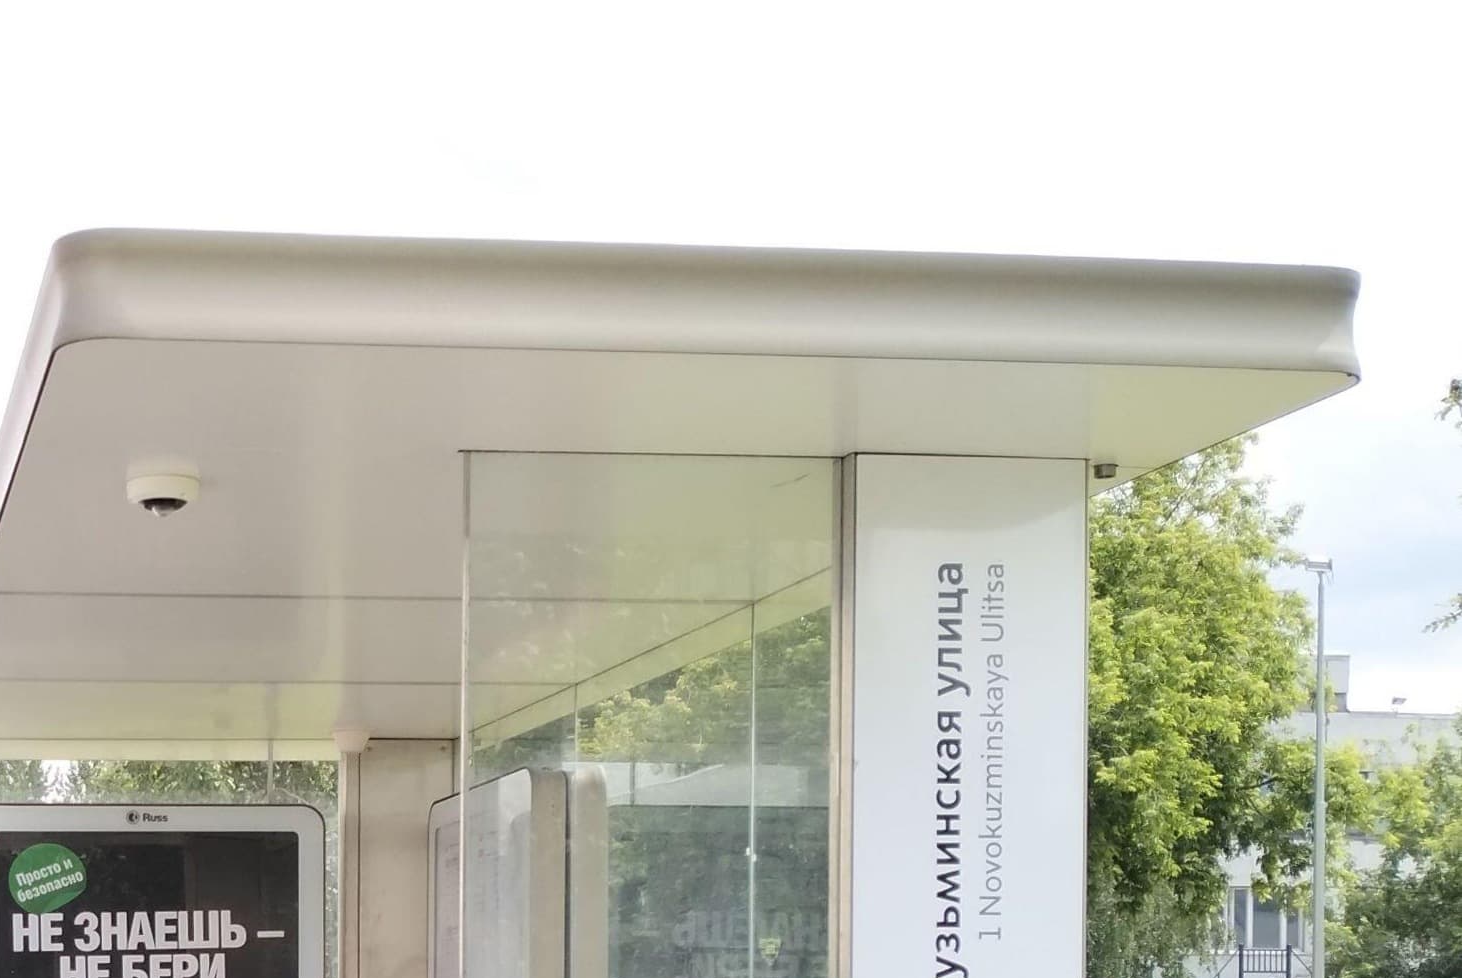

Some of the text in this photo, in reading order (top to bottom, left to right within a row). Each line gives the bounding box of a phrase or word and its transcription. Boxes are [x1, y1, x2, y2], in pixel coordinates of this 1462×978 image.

[938, 563, 971, 697] улица
[979, 564, 1009, 940] 1 Novokuzminskaya Ulitsa
[142, 812, 169, 822] Russ
[15, 858, 73, 887] Просто и
[17, 871, 84, 902] безопасно
[12, 912, 64, 952] НЕ
[73, 910, 247, 951] ЗНАЕШЬ
